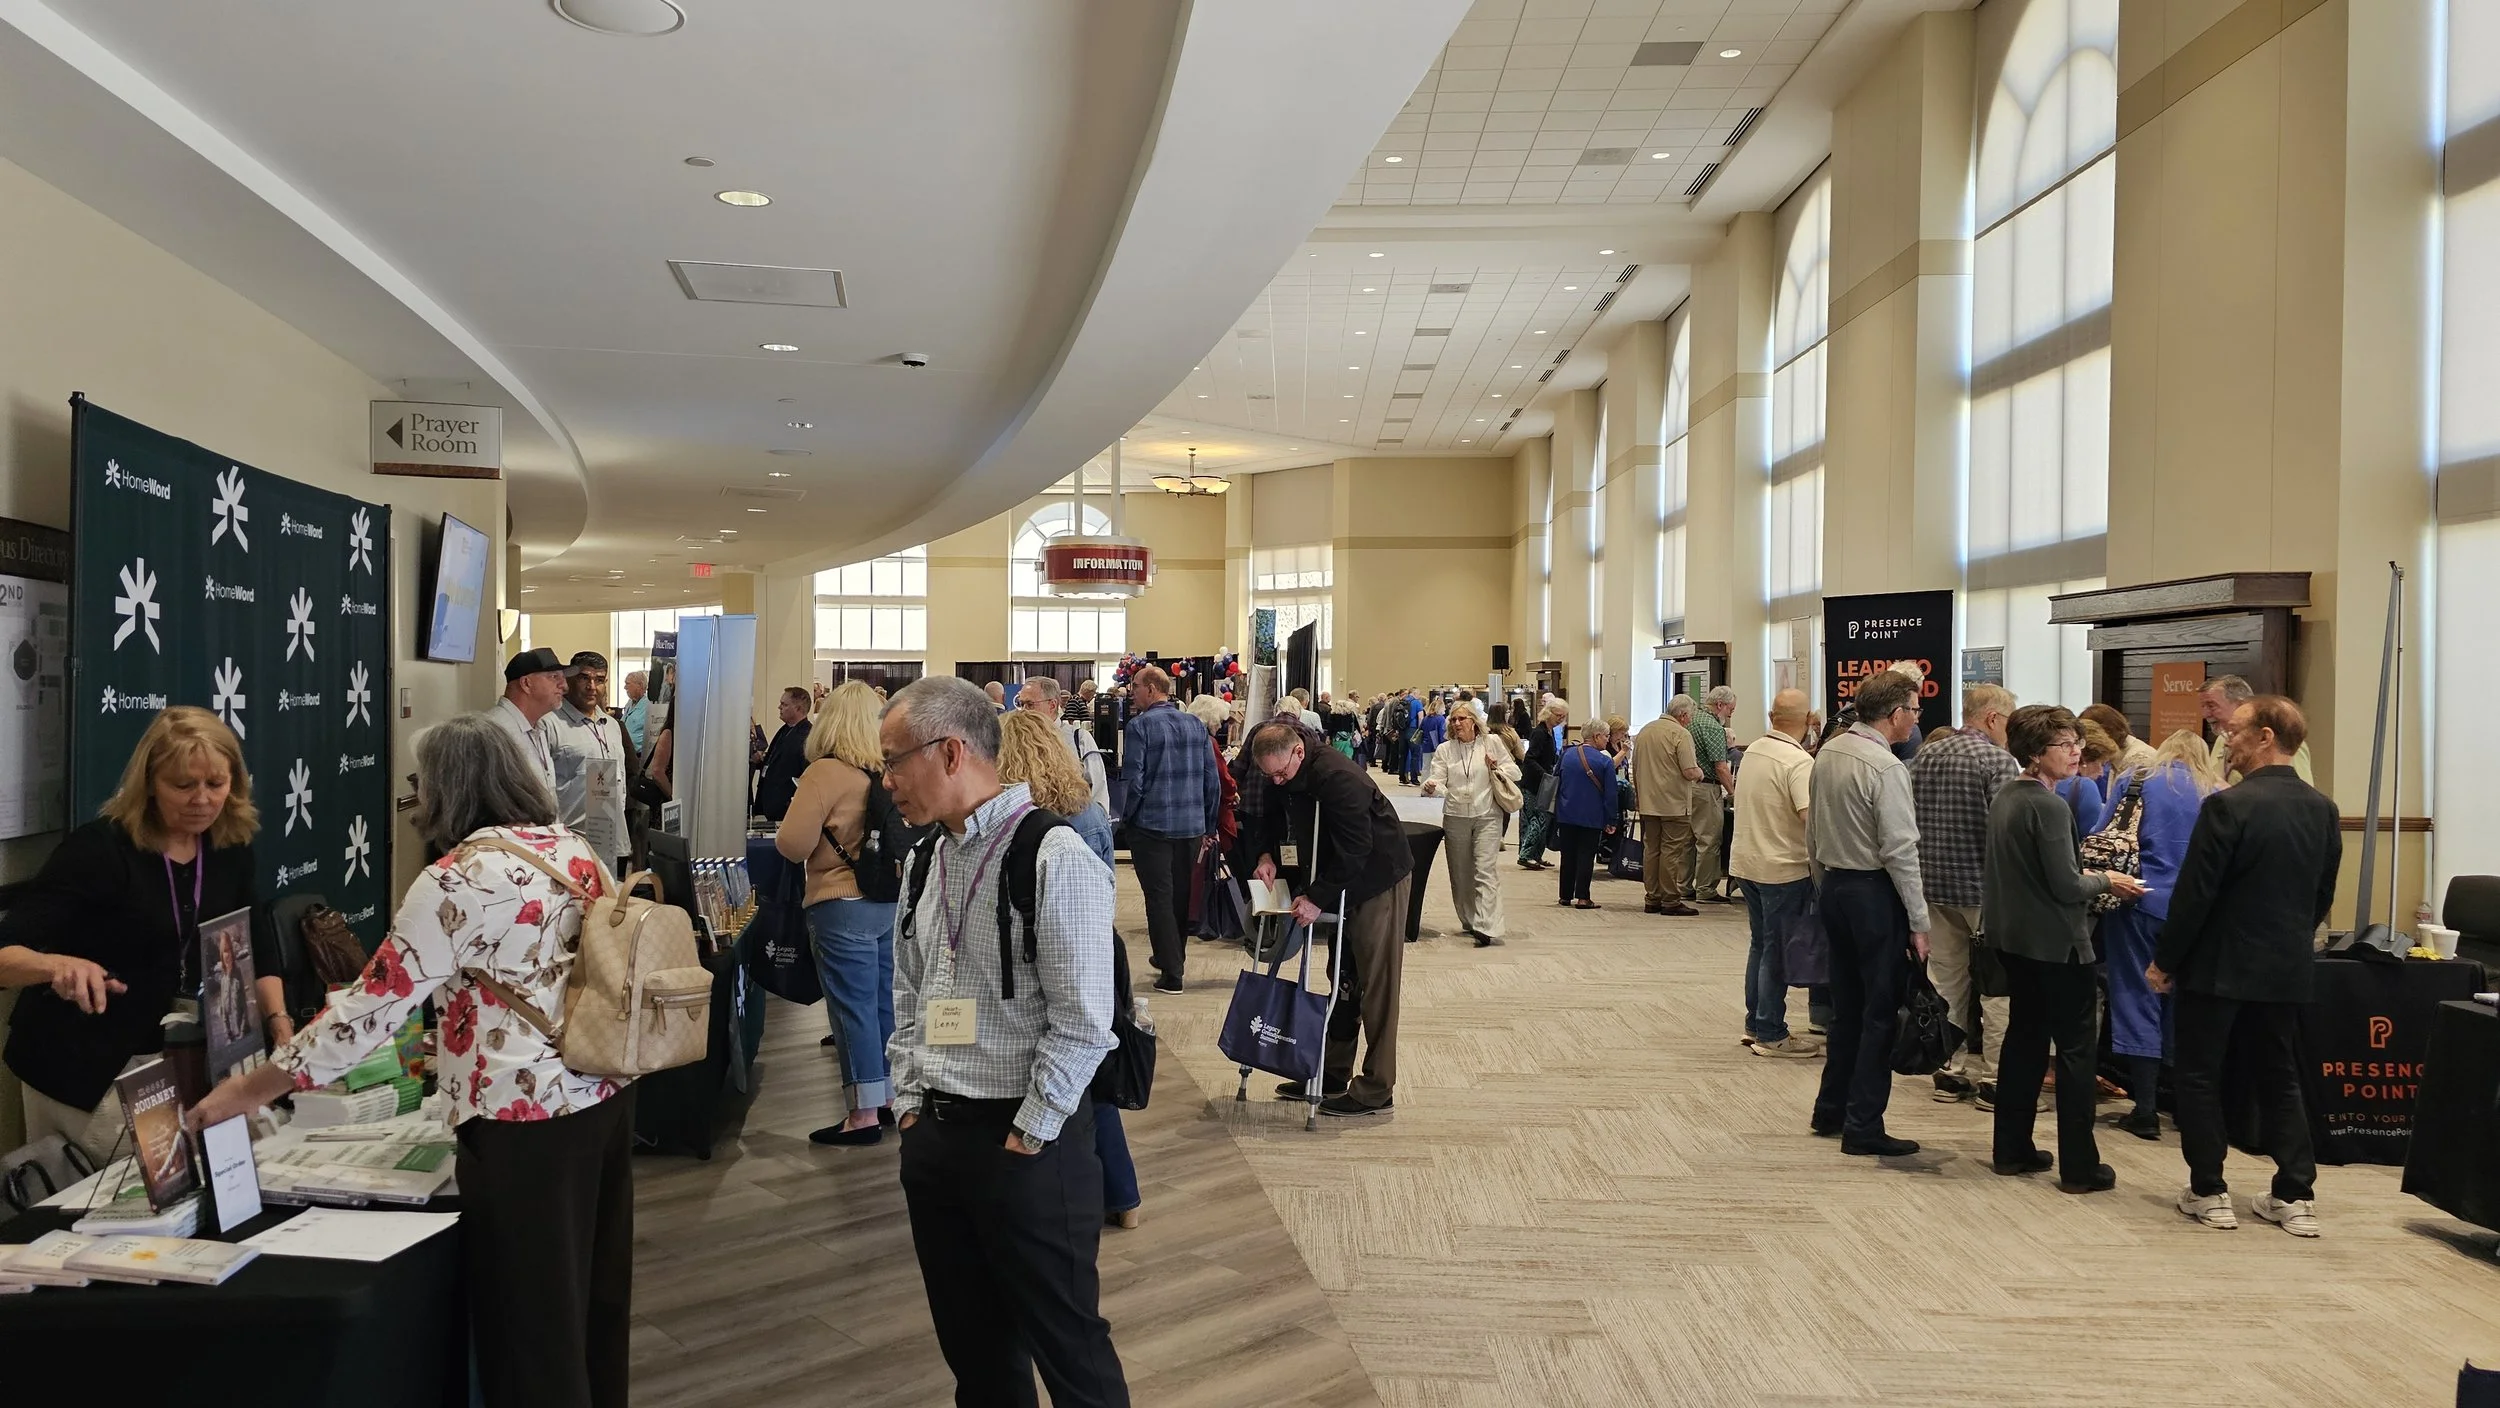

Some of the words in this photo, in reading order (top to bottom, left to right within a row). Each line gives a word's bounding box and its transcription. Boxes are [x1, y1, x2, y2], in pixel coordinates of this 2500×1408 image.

[411, 413, 480, 438] Prayer
[411, 433, 477, 454] Room
[122, 469, 171, 500] HomeWord
[291, 519, 323, 540] HomeWord
[1073, 557, 1143, 571] INFORMATION
[215, 582, 254, 603] HomeWord
[1864, 617, 1923, 629] PRESENCE
[1864, 630, 1899, 640] POINT
[2163, 673, 2194, 693] Serve
[118, 692, 167, 710] HomeWord
[288, 858, 318, 880] HomeWord
[934, 1018, 960, 1031] Lenny
[1263, 1023, 1281, 1035] Legacy
[133, 1085, 177, 1115] JOURNEY
[2343, 1083, 2418, 1100] POINT
[2372, 1113, 2406, 1123] YOUR
